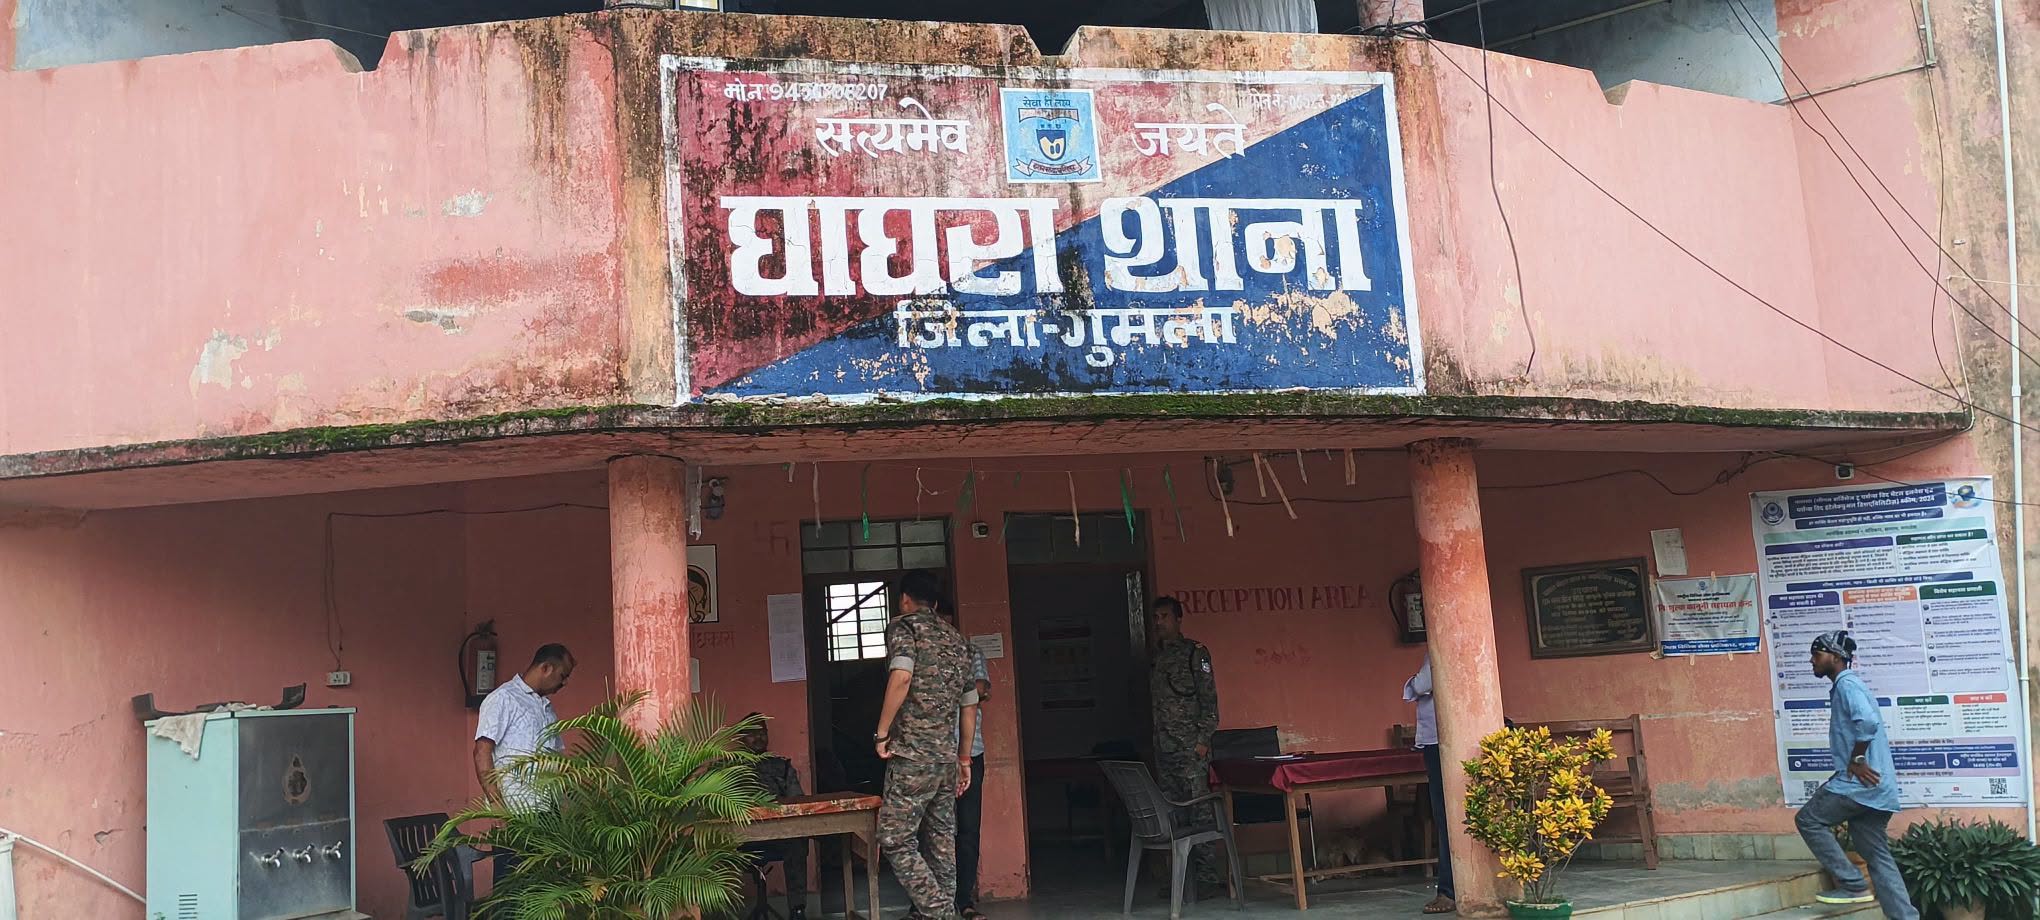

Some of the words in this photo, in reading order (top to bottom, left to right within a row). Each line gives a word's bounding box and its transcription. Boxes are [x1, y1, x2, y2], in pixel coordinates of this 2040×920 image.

[1022, 96, 1041, 107] सेवा
[815, 97, 971, 158] सत्यमेव
[1131, 103, 1248, 159] जयते
[720, 196, 1065, 295] घाघरा
[1100, 196, 1372, 292] थाना
[1919, 494, 1936, 503] 2024
[1175, 584, 1304, 615] RECEPTION
[1311, 583, 1369, 609] AREA
